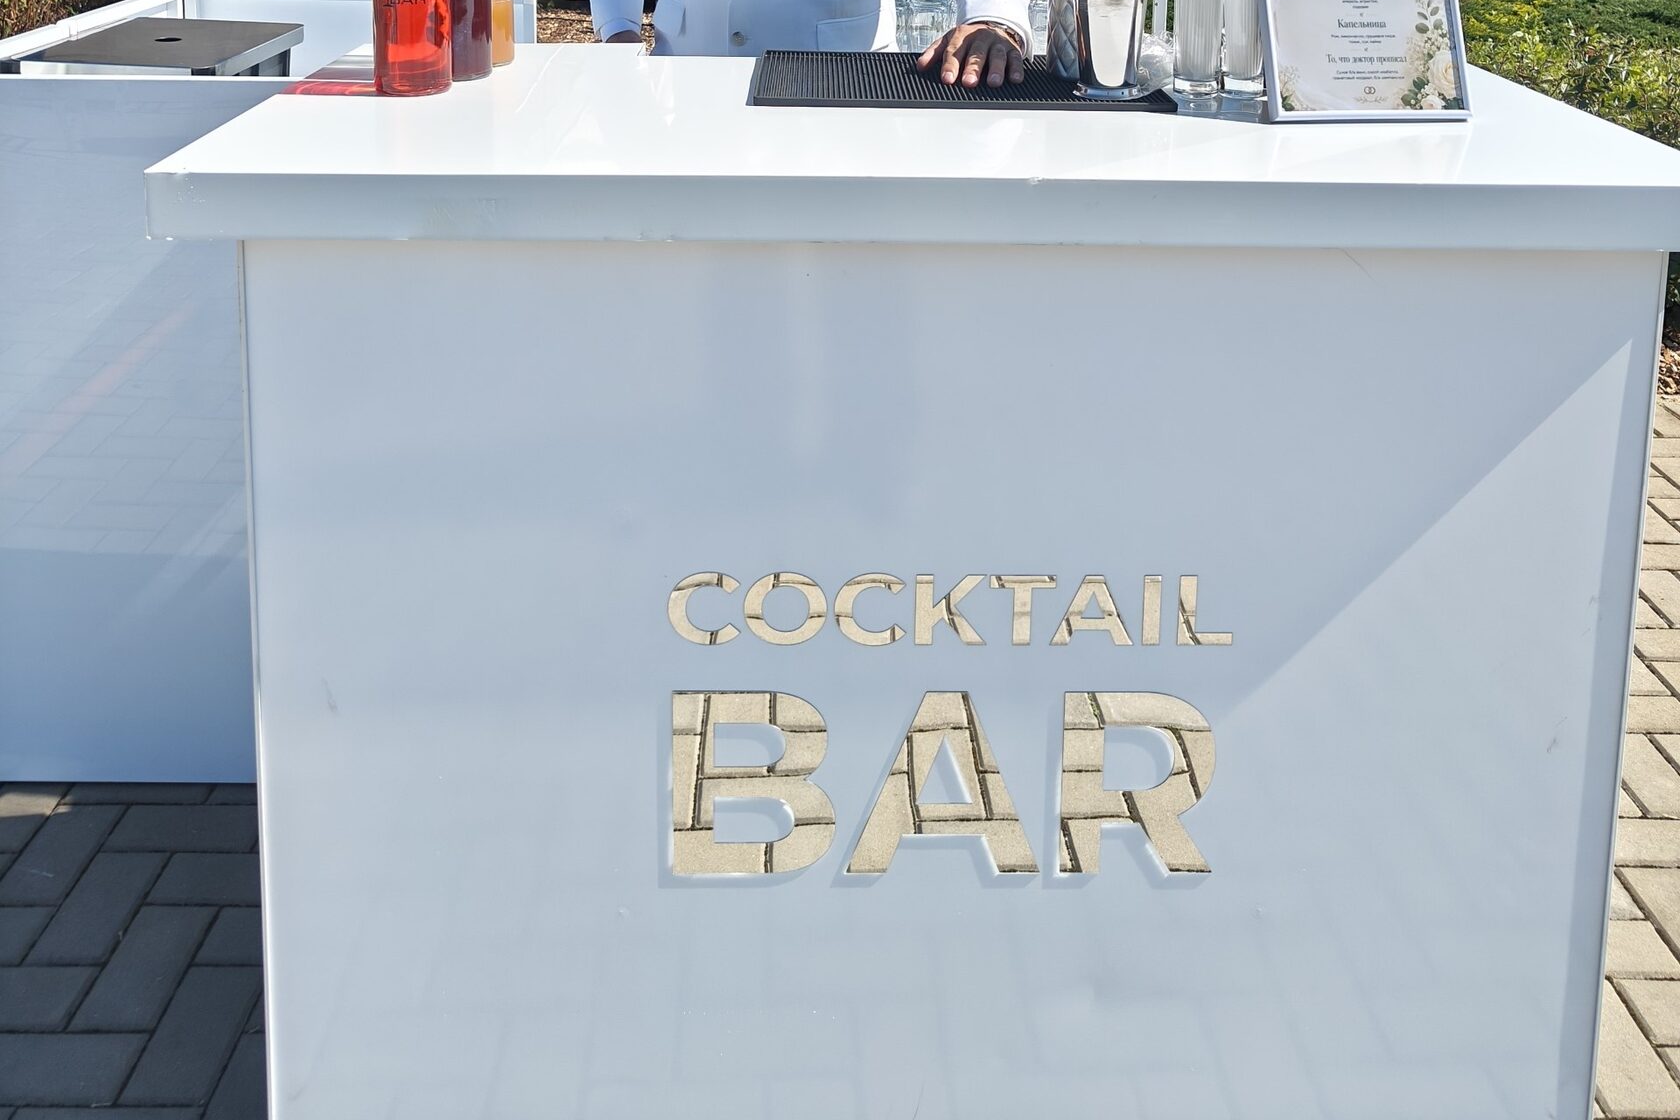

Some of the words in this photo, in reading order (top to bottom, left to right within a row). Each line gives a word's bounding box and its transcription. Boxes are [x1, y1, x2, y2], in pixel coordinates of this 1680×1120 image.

[1337, 18, 1387, 30] Капельница
[1326, 53, 1338, 64] То,
[1338, 55, 1351, 63] что
[1351, 55, 1375, 65] доктор
[1375, 55, 1407, 65] прописал
[667, 571, 1233, 646] COCKTAIL
[671, 690, 1217, 875] BAR
